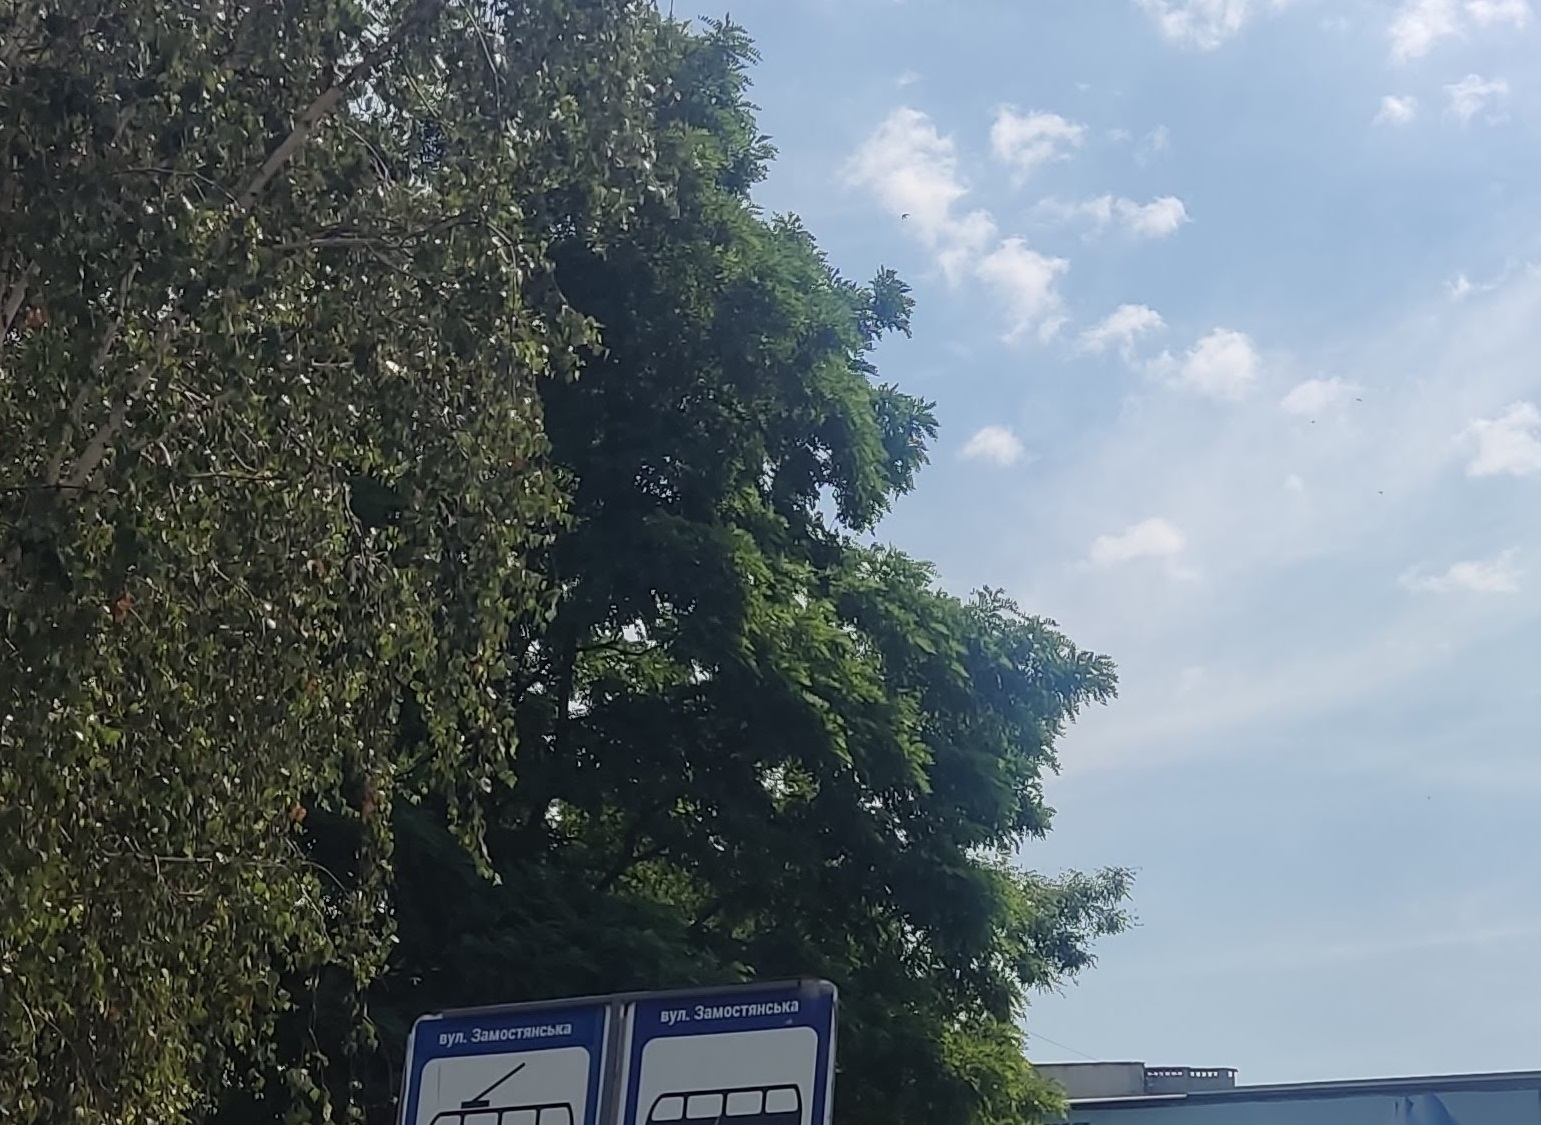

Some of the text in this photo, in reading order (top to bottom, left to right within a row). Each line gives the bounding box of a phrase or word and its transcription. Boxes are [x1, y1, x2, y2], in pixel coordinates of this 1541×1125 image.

[660, 1000, 799, 1026] вул. Замостянська
[439, 1022, 572, 1048] вул. Замостянська
